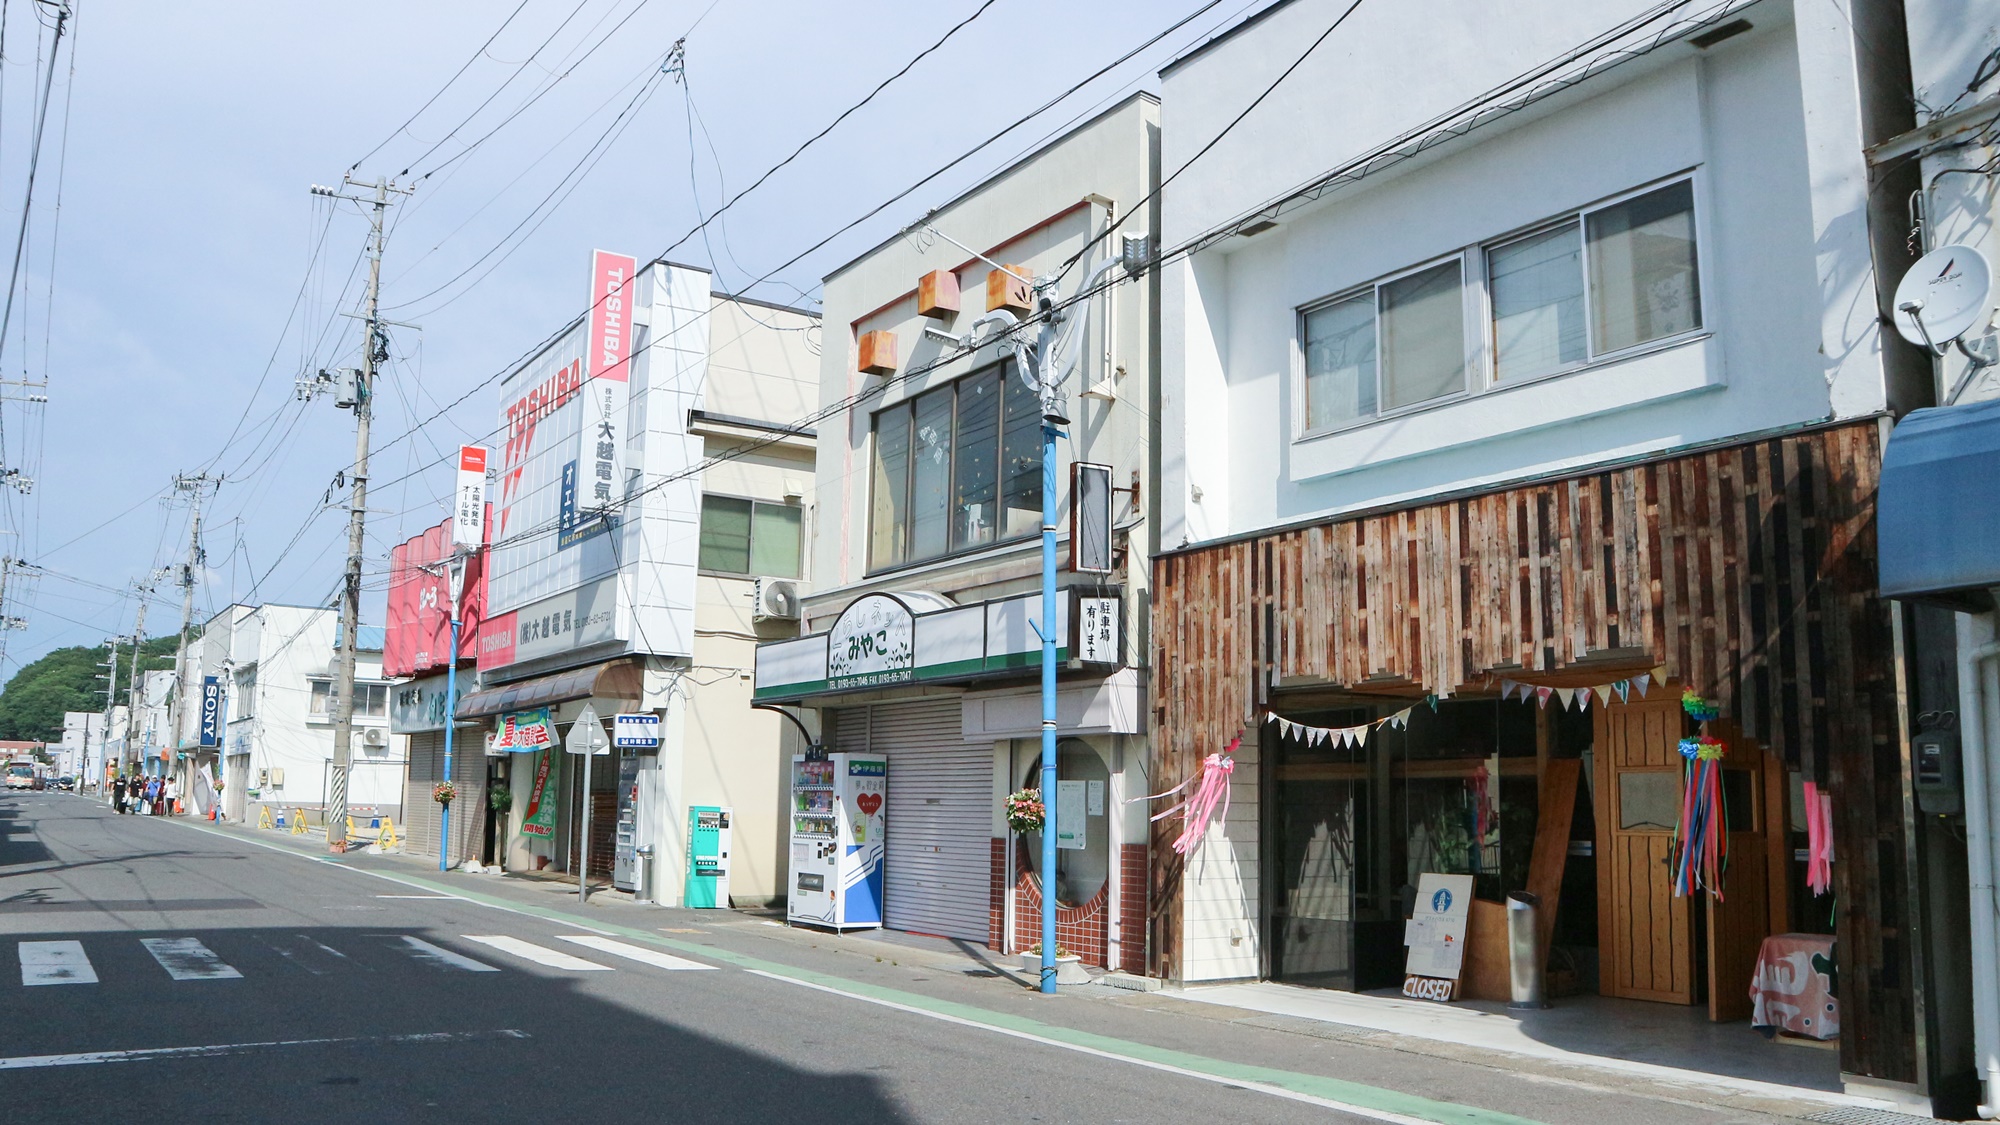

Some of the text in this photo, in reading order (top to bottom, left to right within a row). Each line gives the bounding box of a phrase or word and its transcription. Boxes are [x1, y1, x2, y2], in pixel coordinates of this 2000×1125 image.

[603, 268, 623, 366] TOSHIBA
[507, 357, 581, 440] TOSHIBA
[604, 387, 612, 419] 株式会社
[594, 421, 615, 502] 大越電気
[460, 485, 470, 526] オール電化
[471, 486, 480, 527] 太陽光発電
[1086, 605, 1096, 659] 有ります
[1100, 601, 1110, 641] 駐車場
[481, 630, 512, 654] TOSHIBA
[848, 630, 887, 660] みやこ
[869, 674, 877, 683] FAX
[204, 685, 217, 737] SONY
[1402, 977, 1452, 1001] CLOSED
